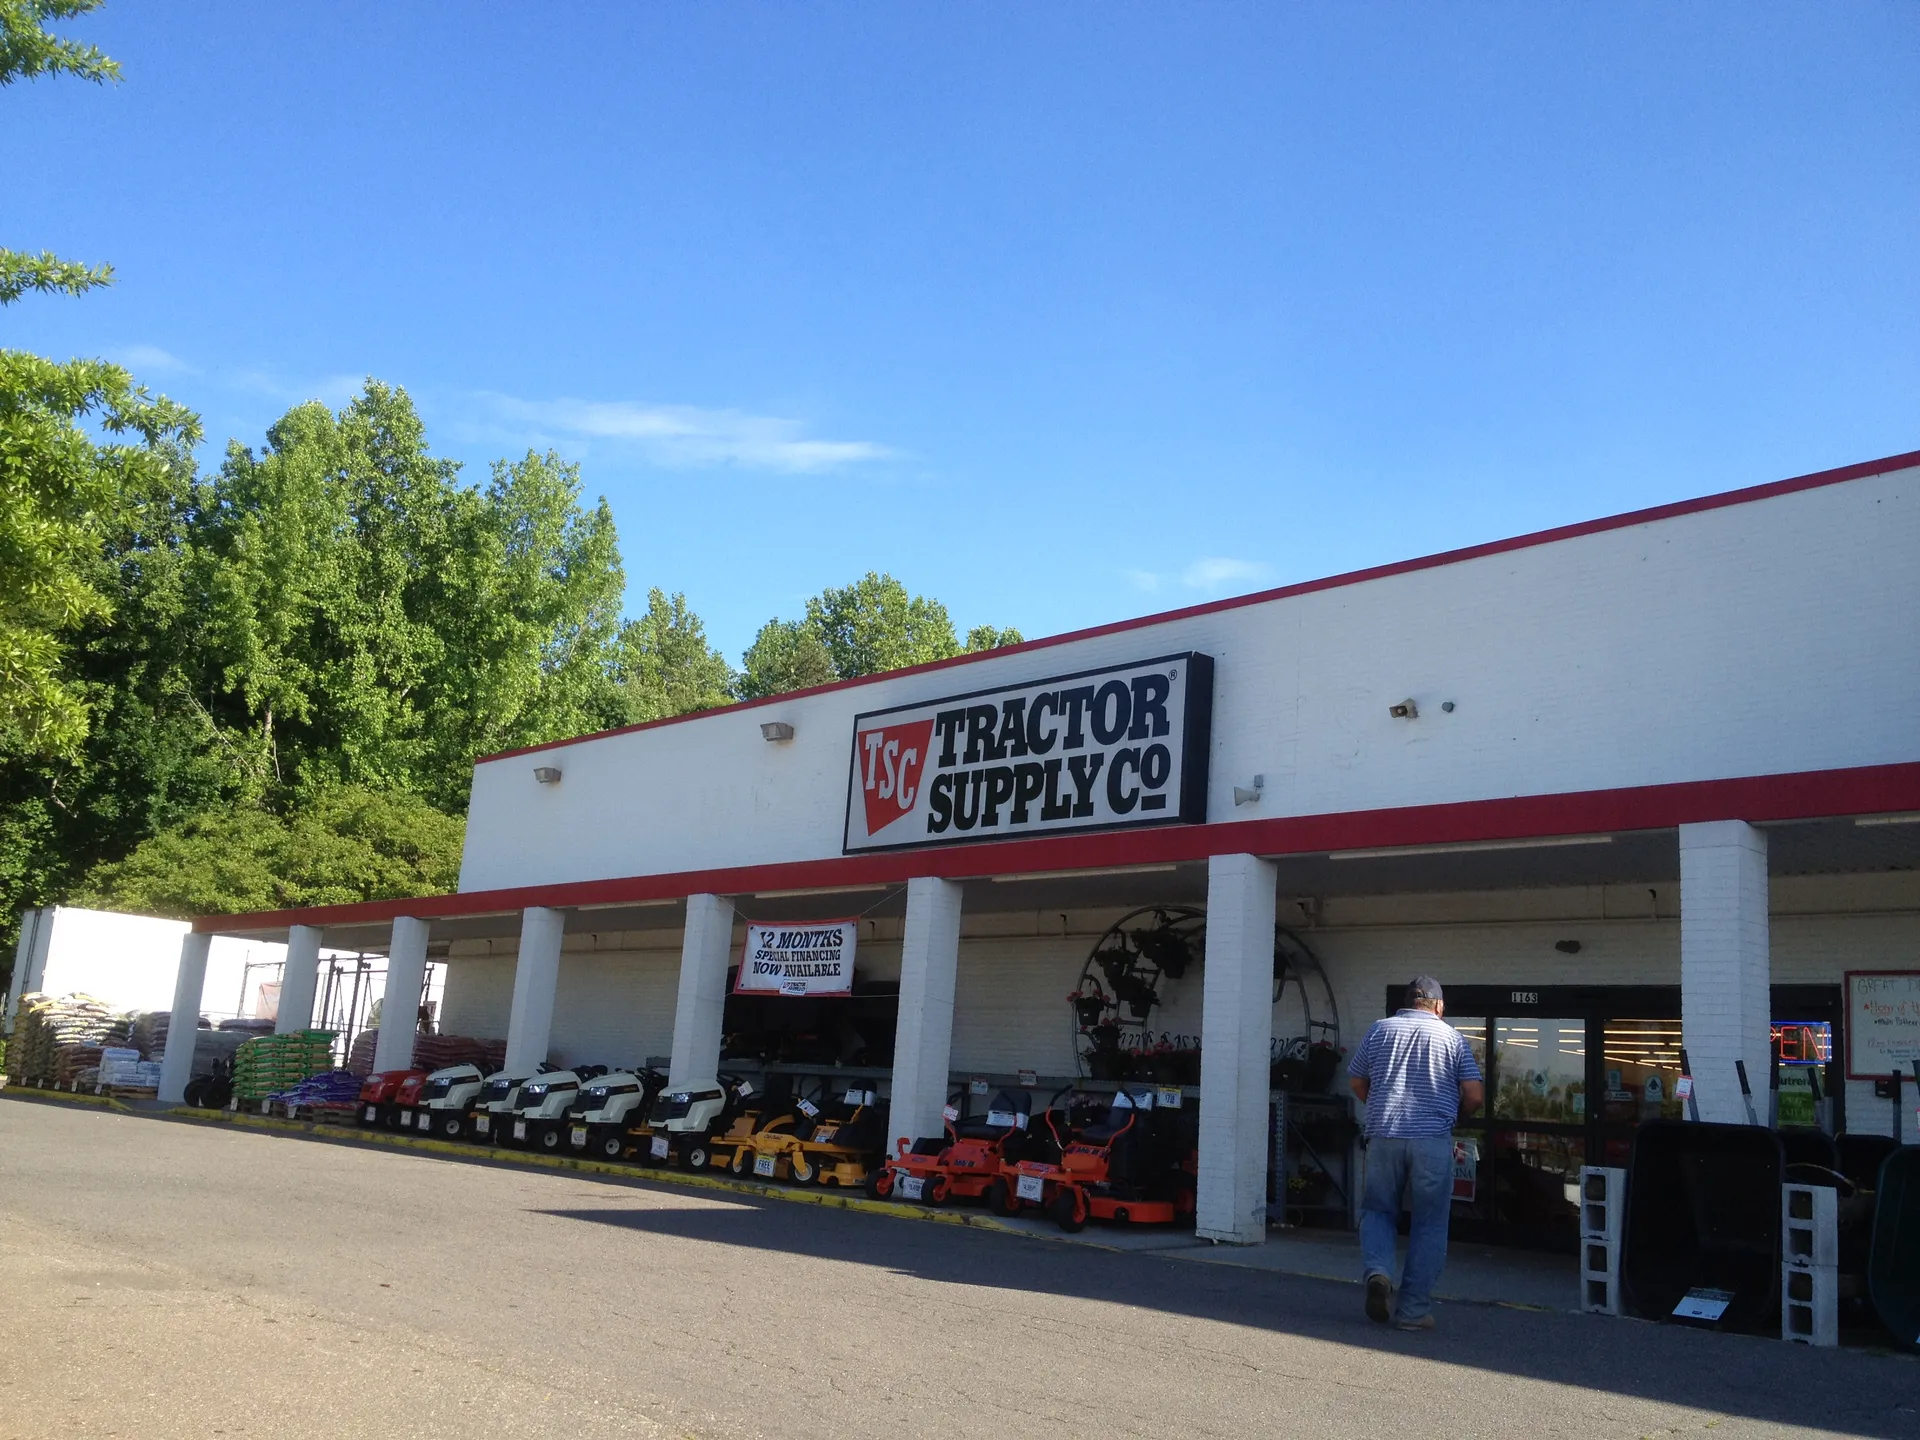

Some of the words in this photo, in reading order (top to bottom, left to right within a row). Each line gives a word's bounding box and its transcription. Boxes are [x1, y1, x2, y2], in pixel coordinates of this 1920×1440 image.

[934, 673, 1170, 768] TRACTOR
[864, 731, 917, 810] TSC
[927, 753, 1104, 834] SUPPLY
[760, 931, 776, 949] 12
[776, 928, 843, 949] MONTHS
[755, 949, 790, 962] SPECIAL
[791, 949, 841, 962] FINANCING
[753, 961, 782, 976] NOW
[783, 962, 841, 977] AVAILABLE
[1513, 993, 1537, 1003] 1163
[758, 1159, 771, 1169] FREE
